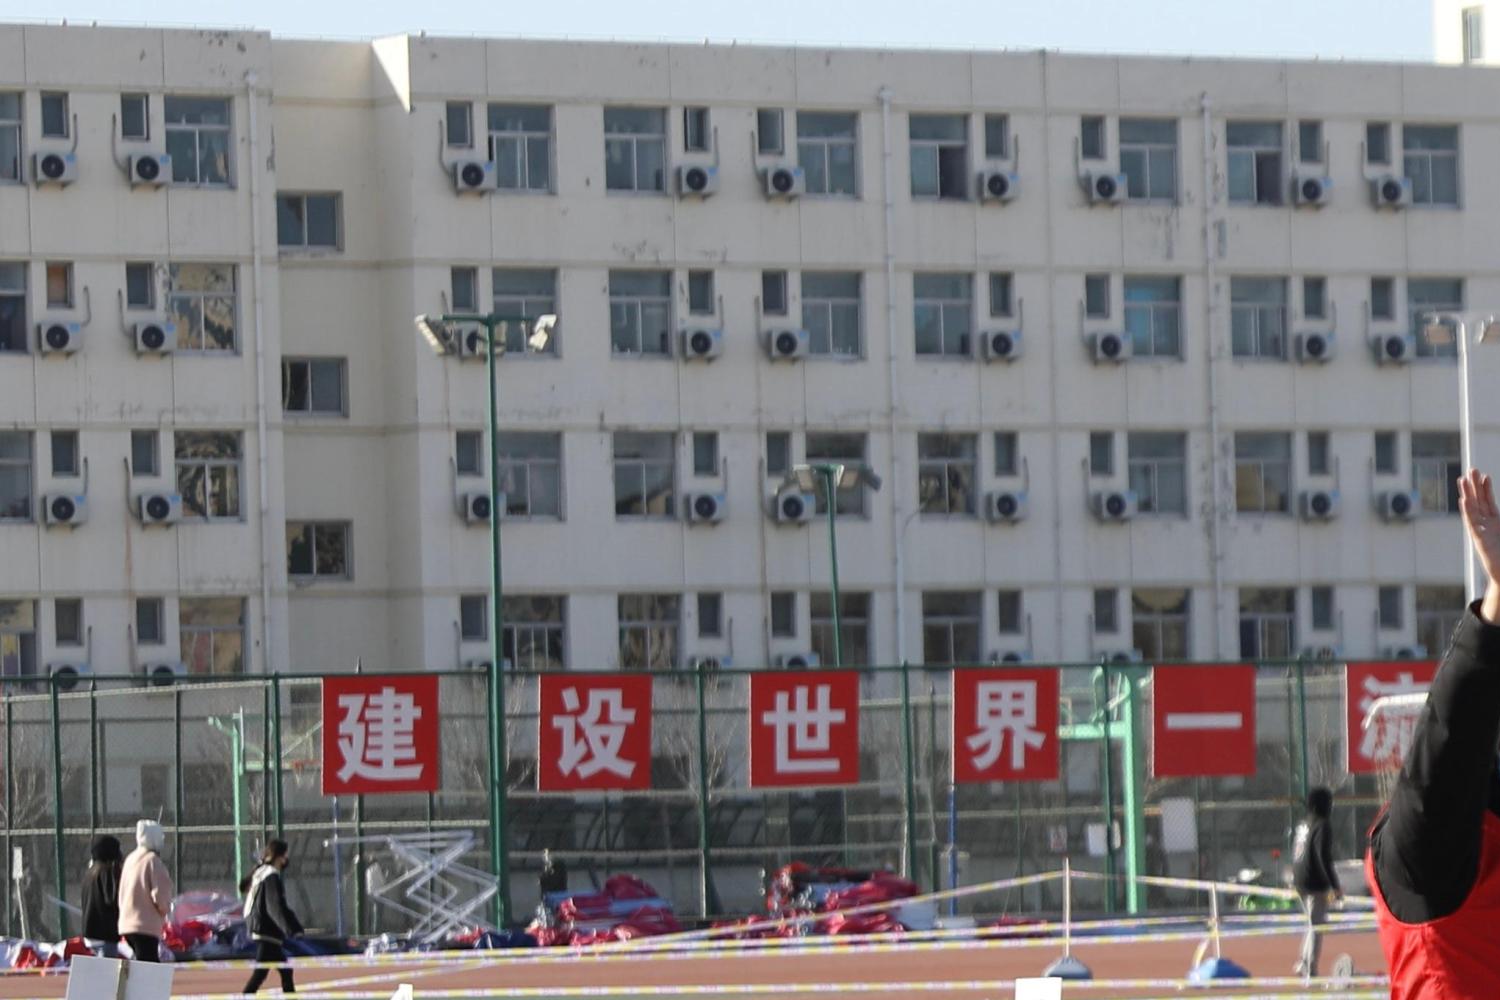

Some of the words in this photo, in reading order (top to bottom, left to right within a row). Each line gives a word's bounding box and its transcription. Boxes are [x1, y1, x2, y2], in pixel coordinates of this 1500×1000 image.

[336, 687, 424, 783] 建
[553, 687, 636, 779] 设
[763, 684, 846, 773] 世
[966, 680, 1047, 770] 界
[1166, 712, 1242, 730] 一
